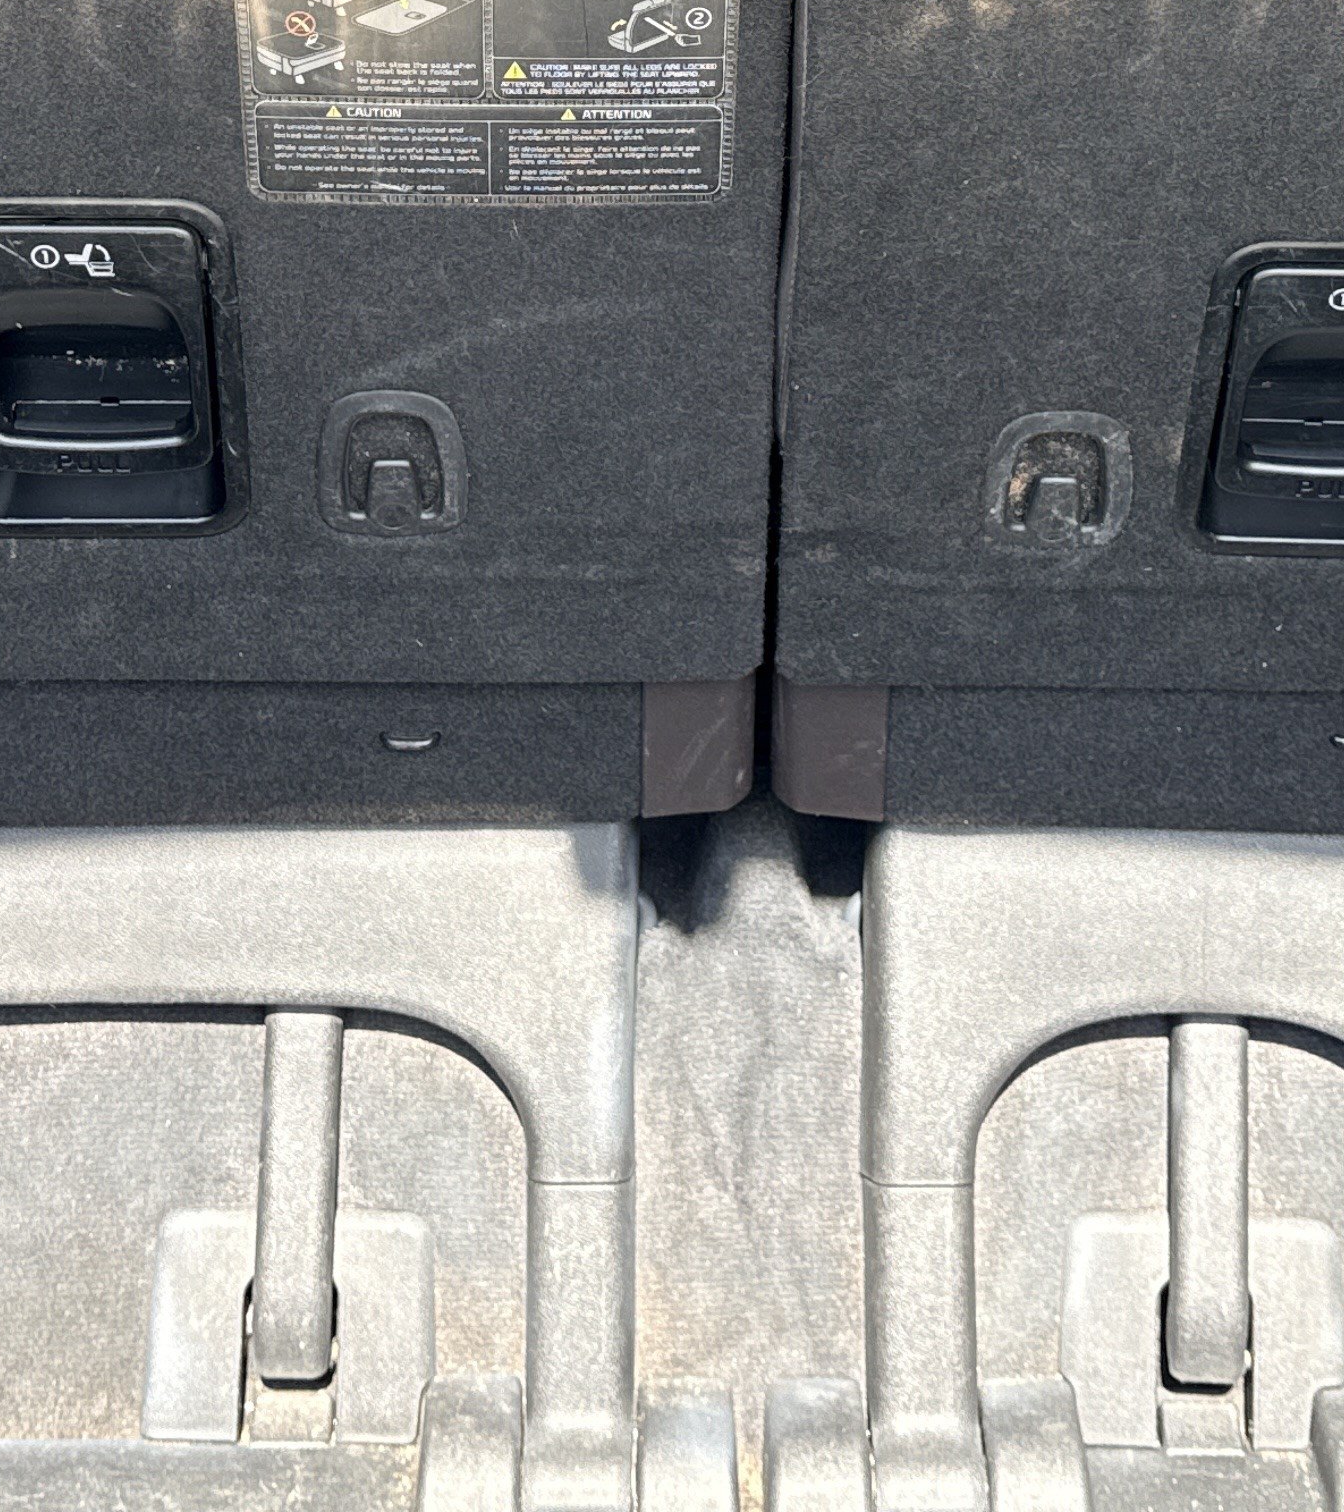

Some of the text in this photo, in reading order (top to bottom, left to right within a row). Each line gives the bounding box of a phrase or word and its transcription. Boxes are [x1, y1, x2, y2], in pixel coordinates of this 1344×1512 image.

[346, 108, 402, 118] CAUTION
[582, 109, 653, 120] ATTENTION
[57, 454, 131, 473] PULL
